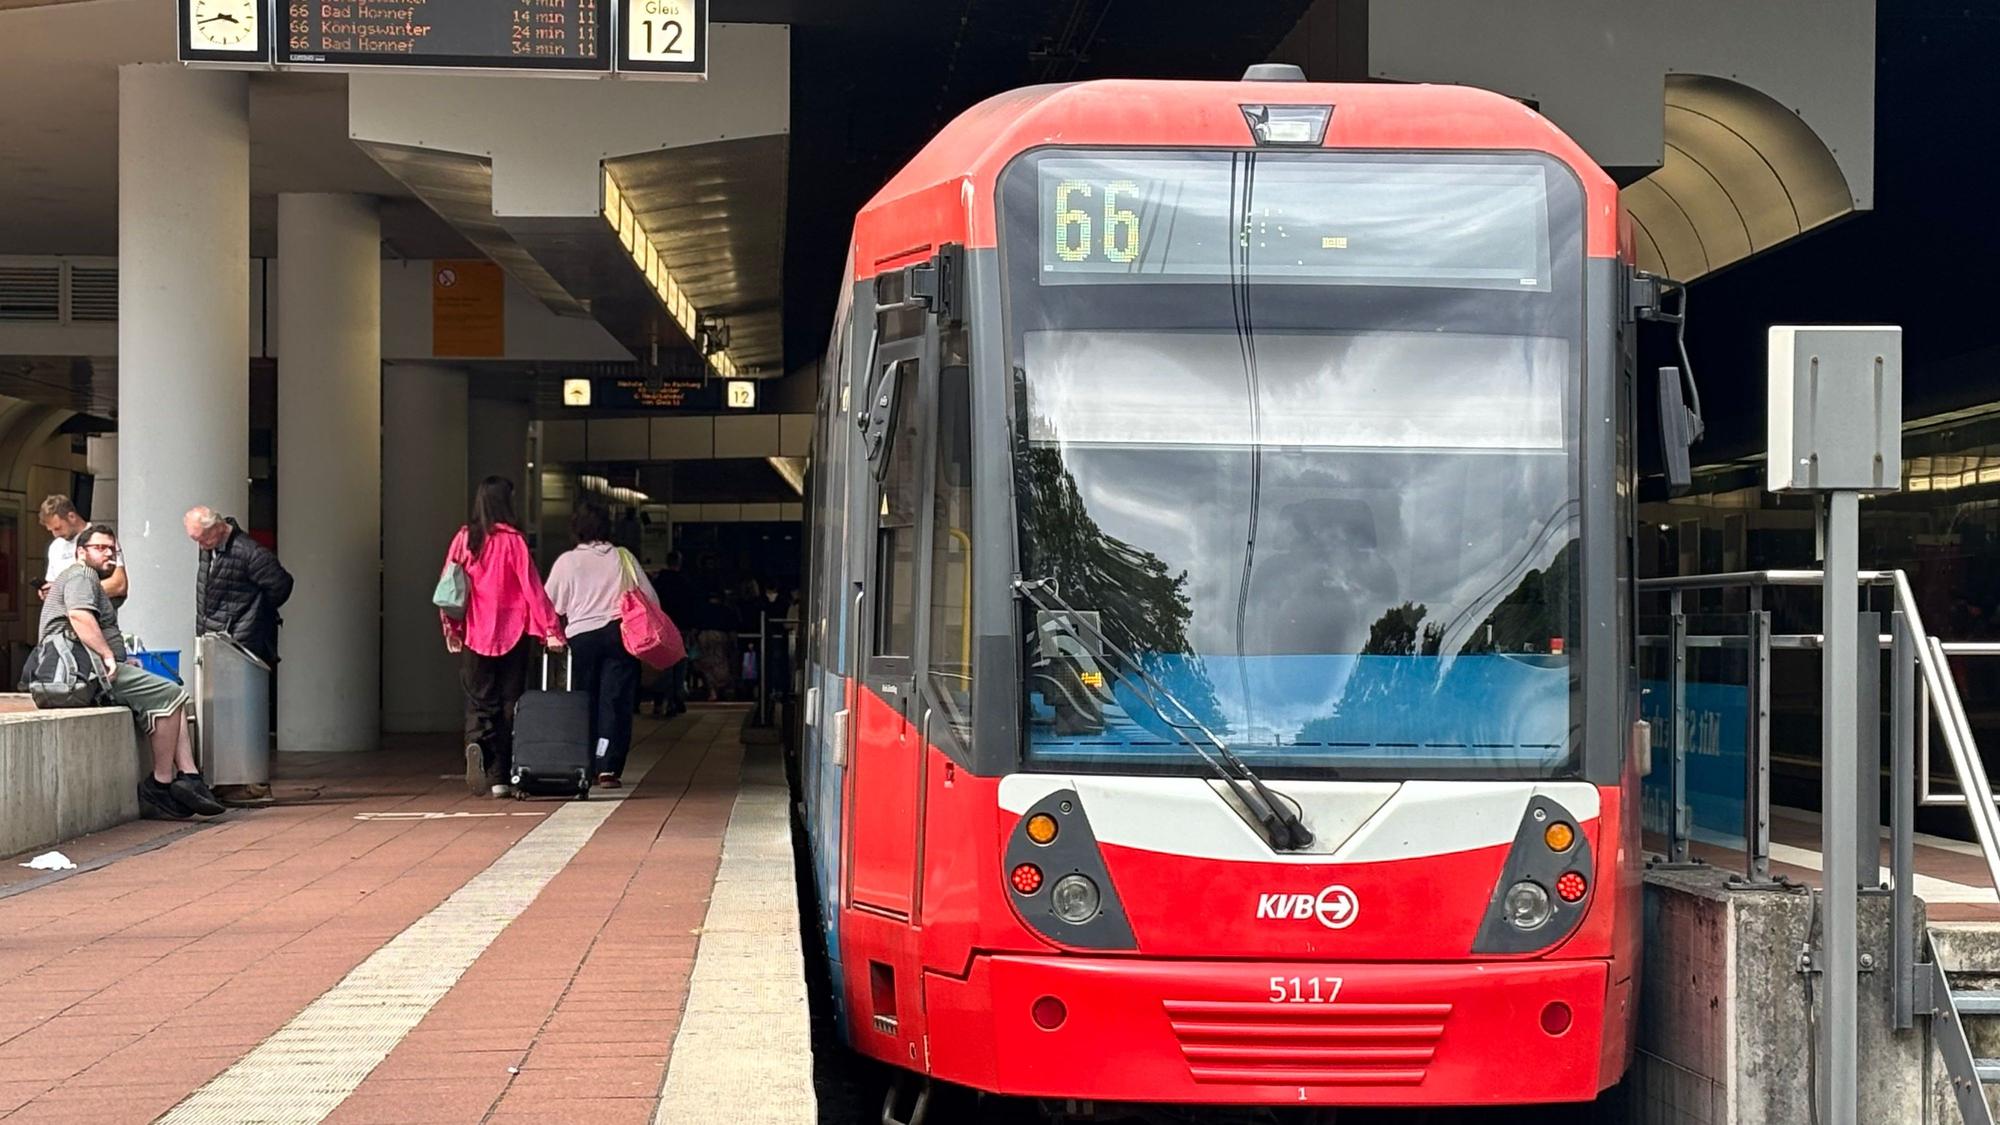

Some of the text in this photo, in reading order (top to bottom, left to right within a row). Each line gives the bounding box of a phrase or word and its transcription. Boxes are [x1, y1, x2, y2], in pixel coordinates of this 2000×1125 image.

[289, 4, 595, 24] 66 Bad Honnef 14 min 11
[645, 0, 679, 15] Gleis
[289, 20, 309, 33] 66
[512, 25, 530, 39] 24
[535, 27, 565, 39] min
[578, 28, 595, 40] 11
[642, 20, 683, 54] 12
[289, 36, 595, 56] 66 Bad Honnef 34 min 11
[1056, 179, 1139, 262] 66
[734, 391, 749, 404] 12
[1256, 894, 1315, 919] KVB
[1268, 976, 1343, 1003] 5117
[1297, 1087, 1308, 1101] 1
